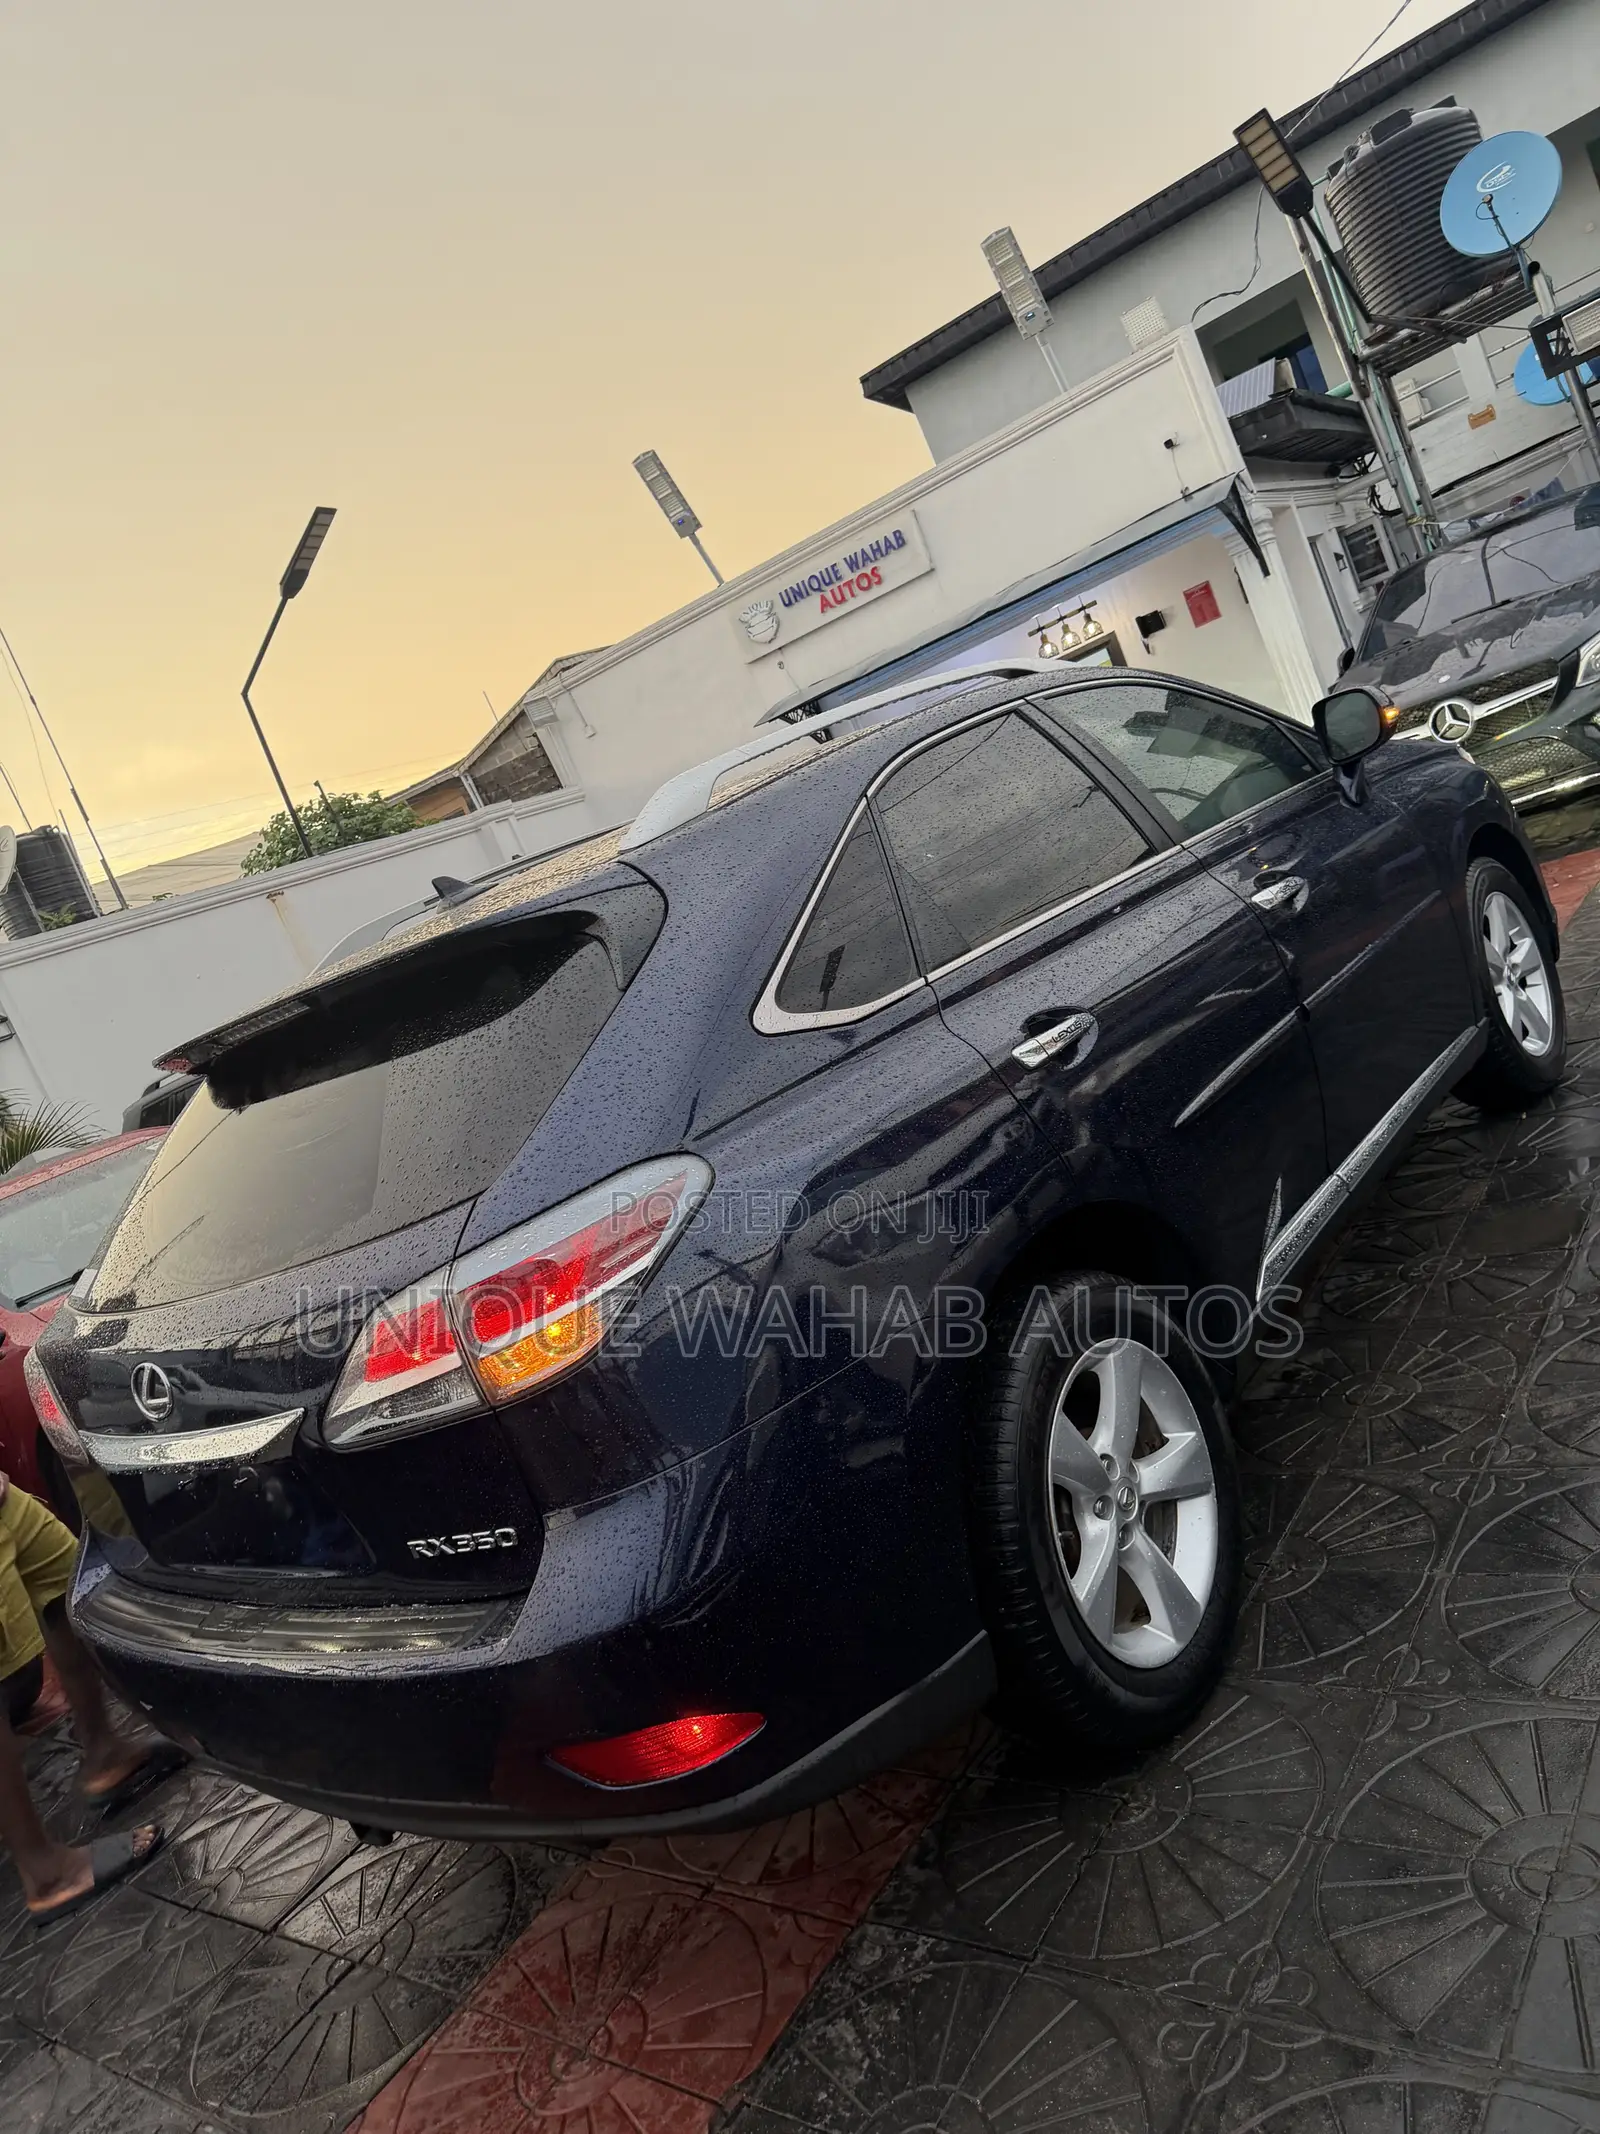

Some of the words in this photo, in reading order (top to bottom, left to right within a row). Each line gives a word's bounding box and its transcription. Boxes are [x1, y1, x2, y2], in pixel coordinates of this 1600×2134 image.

[778, 563, 843, 607] UNIQUE
[843, 529, 906, 573] WAHAB
[819, 566, 883, 614] AUTOS
[407, 1527, 518, 1559] RX350
